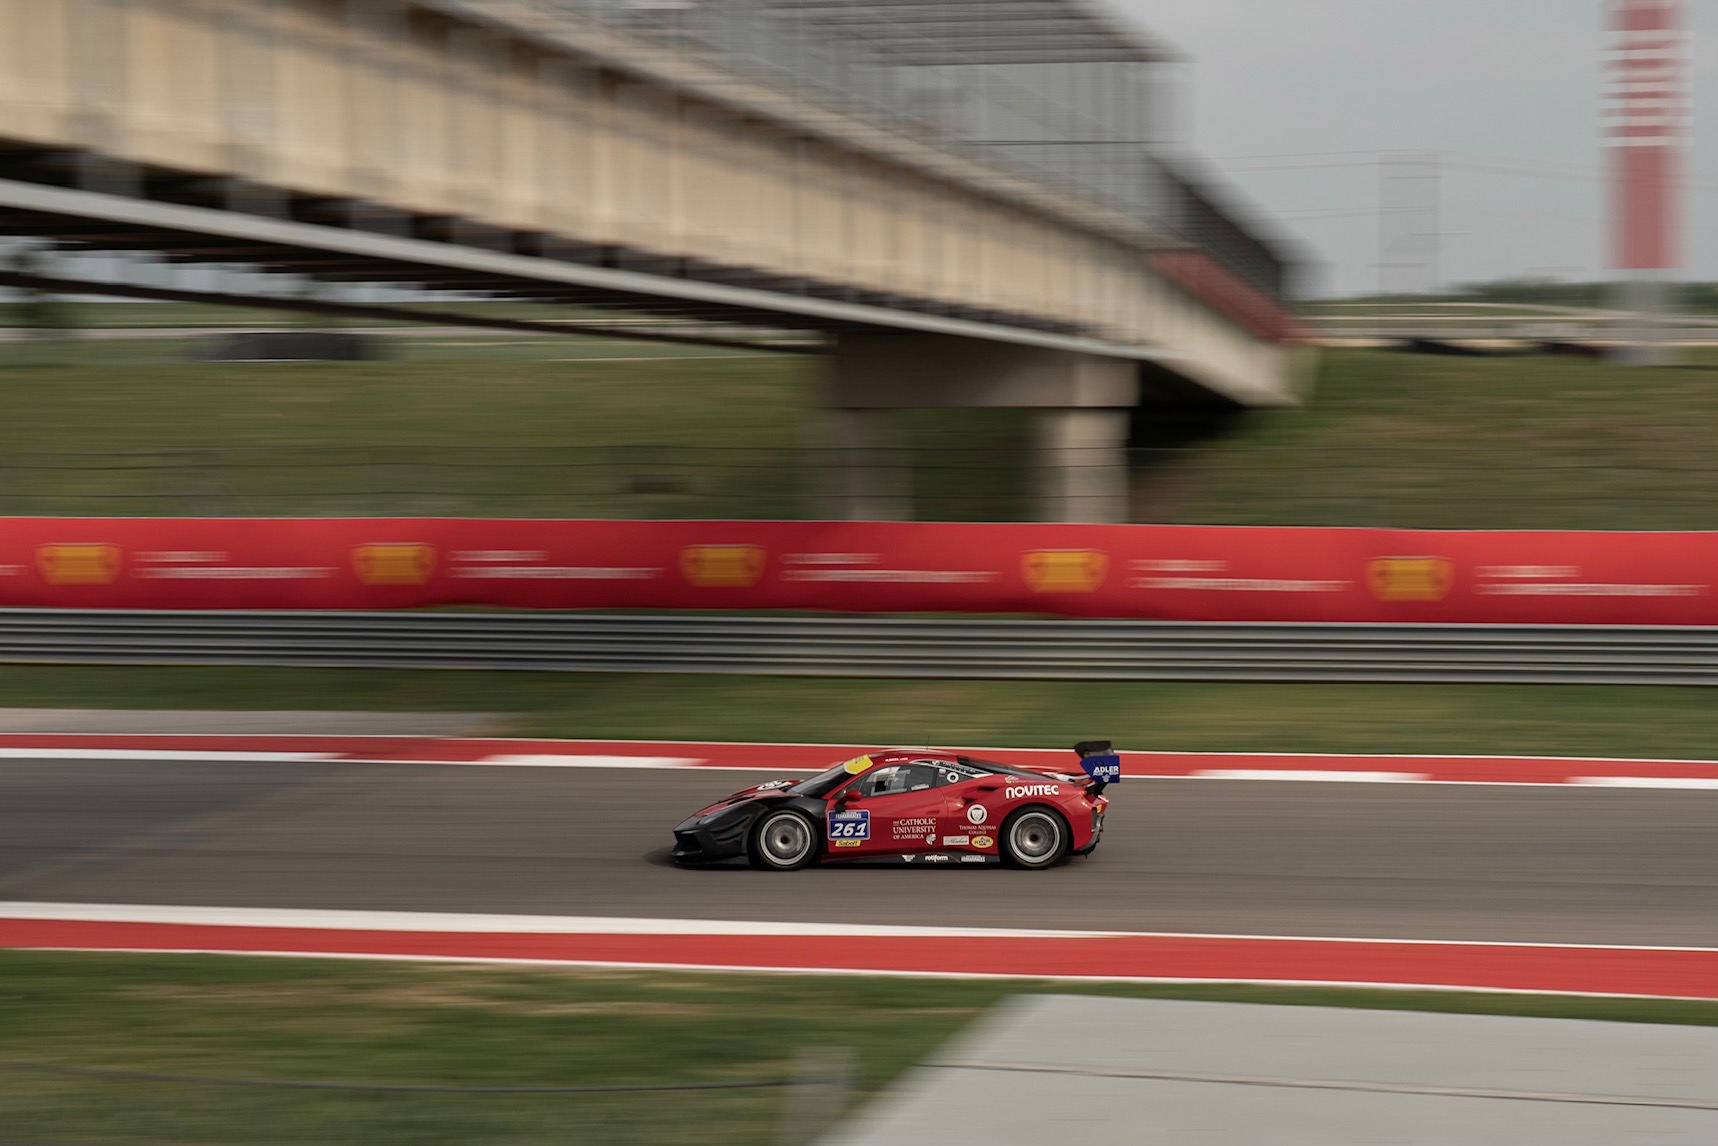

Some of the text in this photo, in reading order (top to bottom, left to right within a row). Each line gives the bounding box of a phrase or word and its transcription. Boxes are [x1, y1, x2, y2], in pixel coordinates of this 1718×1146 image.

[1005, 785, 1059, 798] NOVITEC
[900, 818, 936, 826] CATHOLIC
[831, 822, 867, 836] 261
[893, 825, 936, 834] UNIVERSITY
